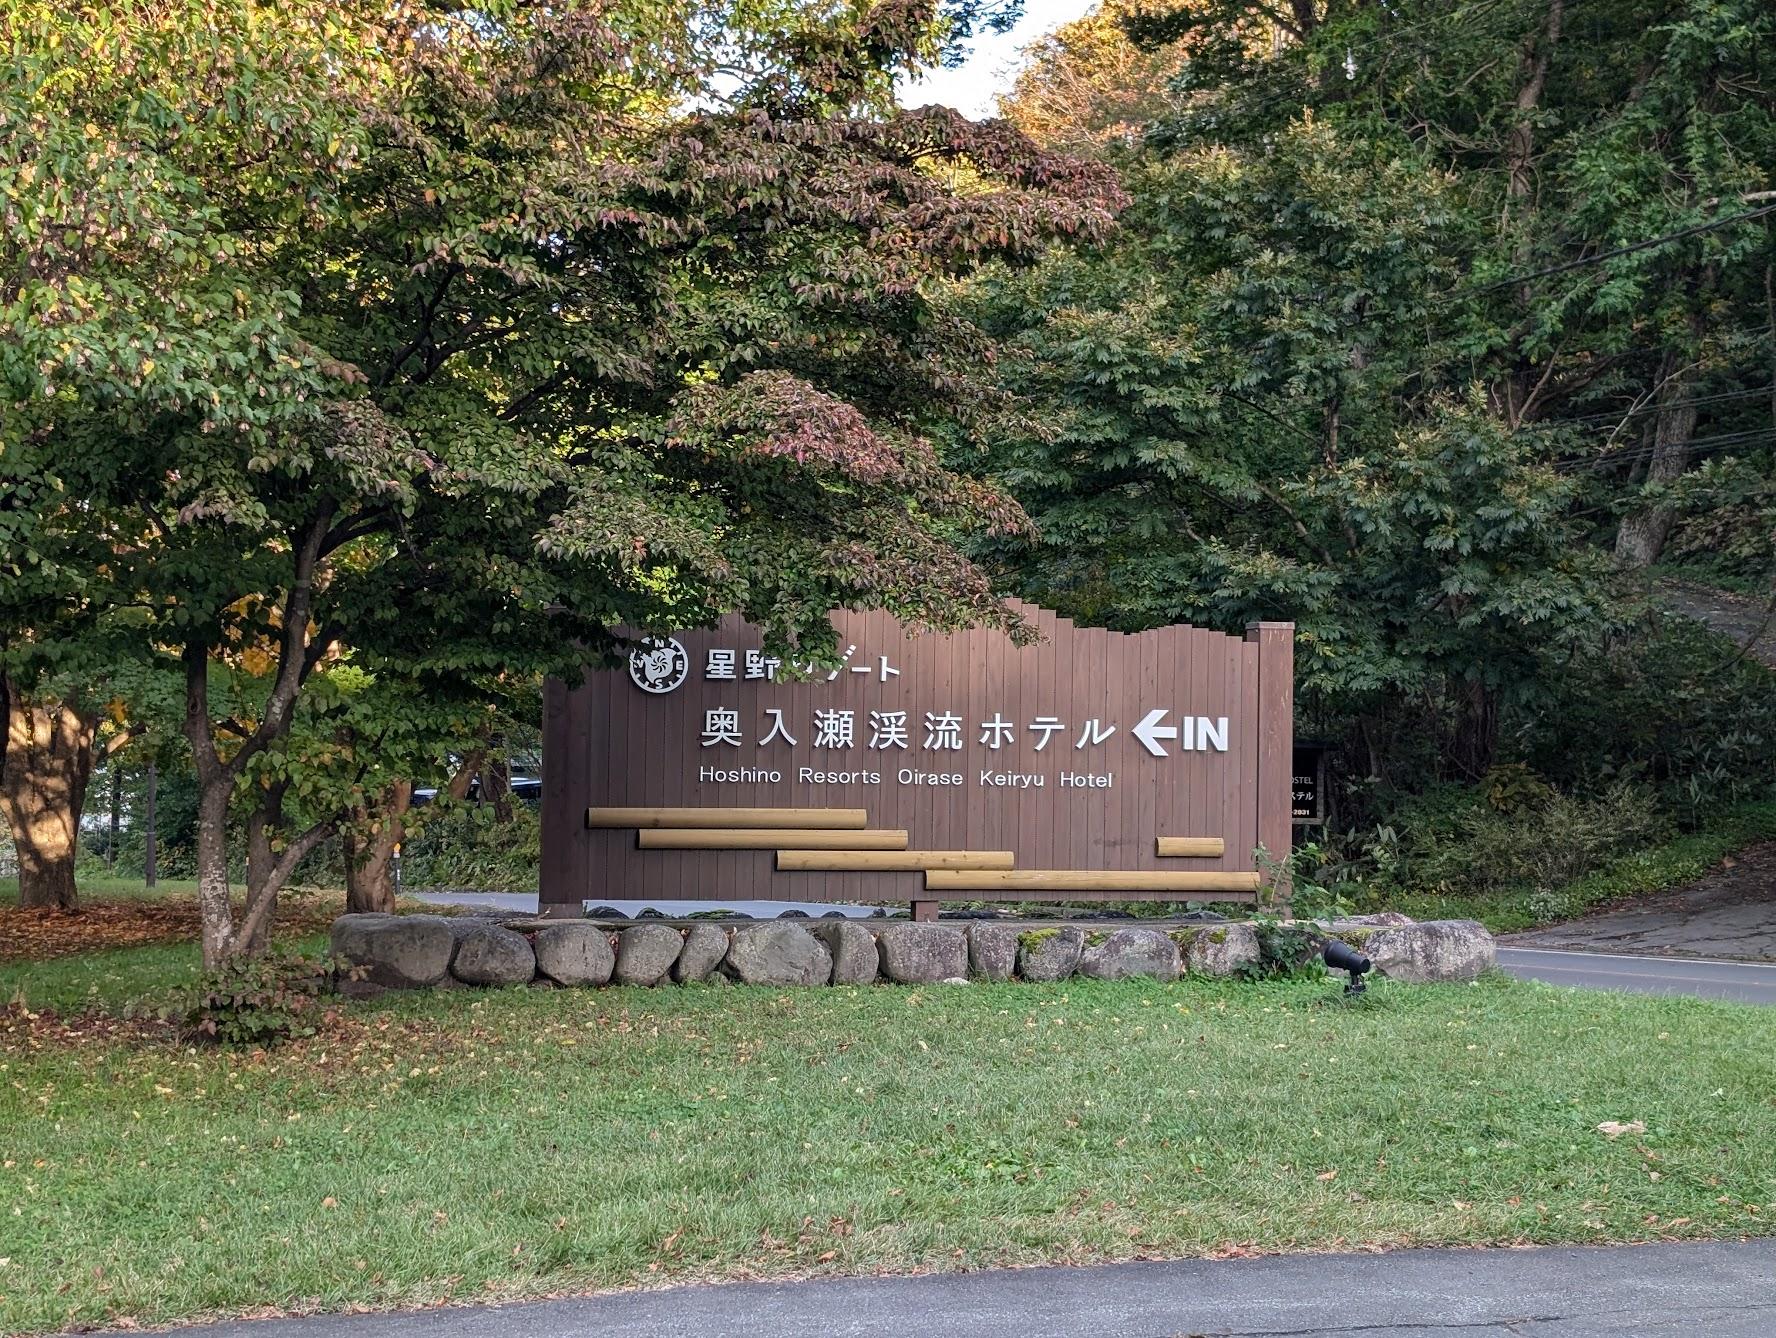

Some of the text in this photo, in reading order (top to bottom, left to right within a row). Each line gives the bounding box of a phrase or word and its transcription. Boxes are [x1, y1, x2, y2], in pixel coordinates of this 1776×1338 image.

[705, 644, 900, 682] 星野ゾート
[701, 706, 1229, 752] 奥入瀬渓流ホテル IN
[699, 766, 1113, 789] Hoshino Resorts Oirase Keiryu Hotel
